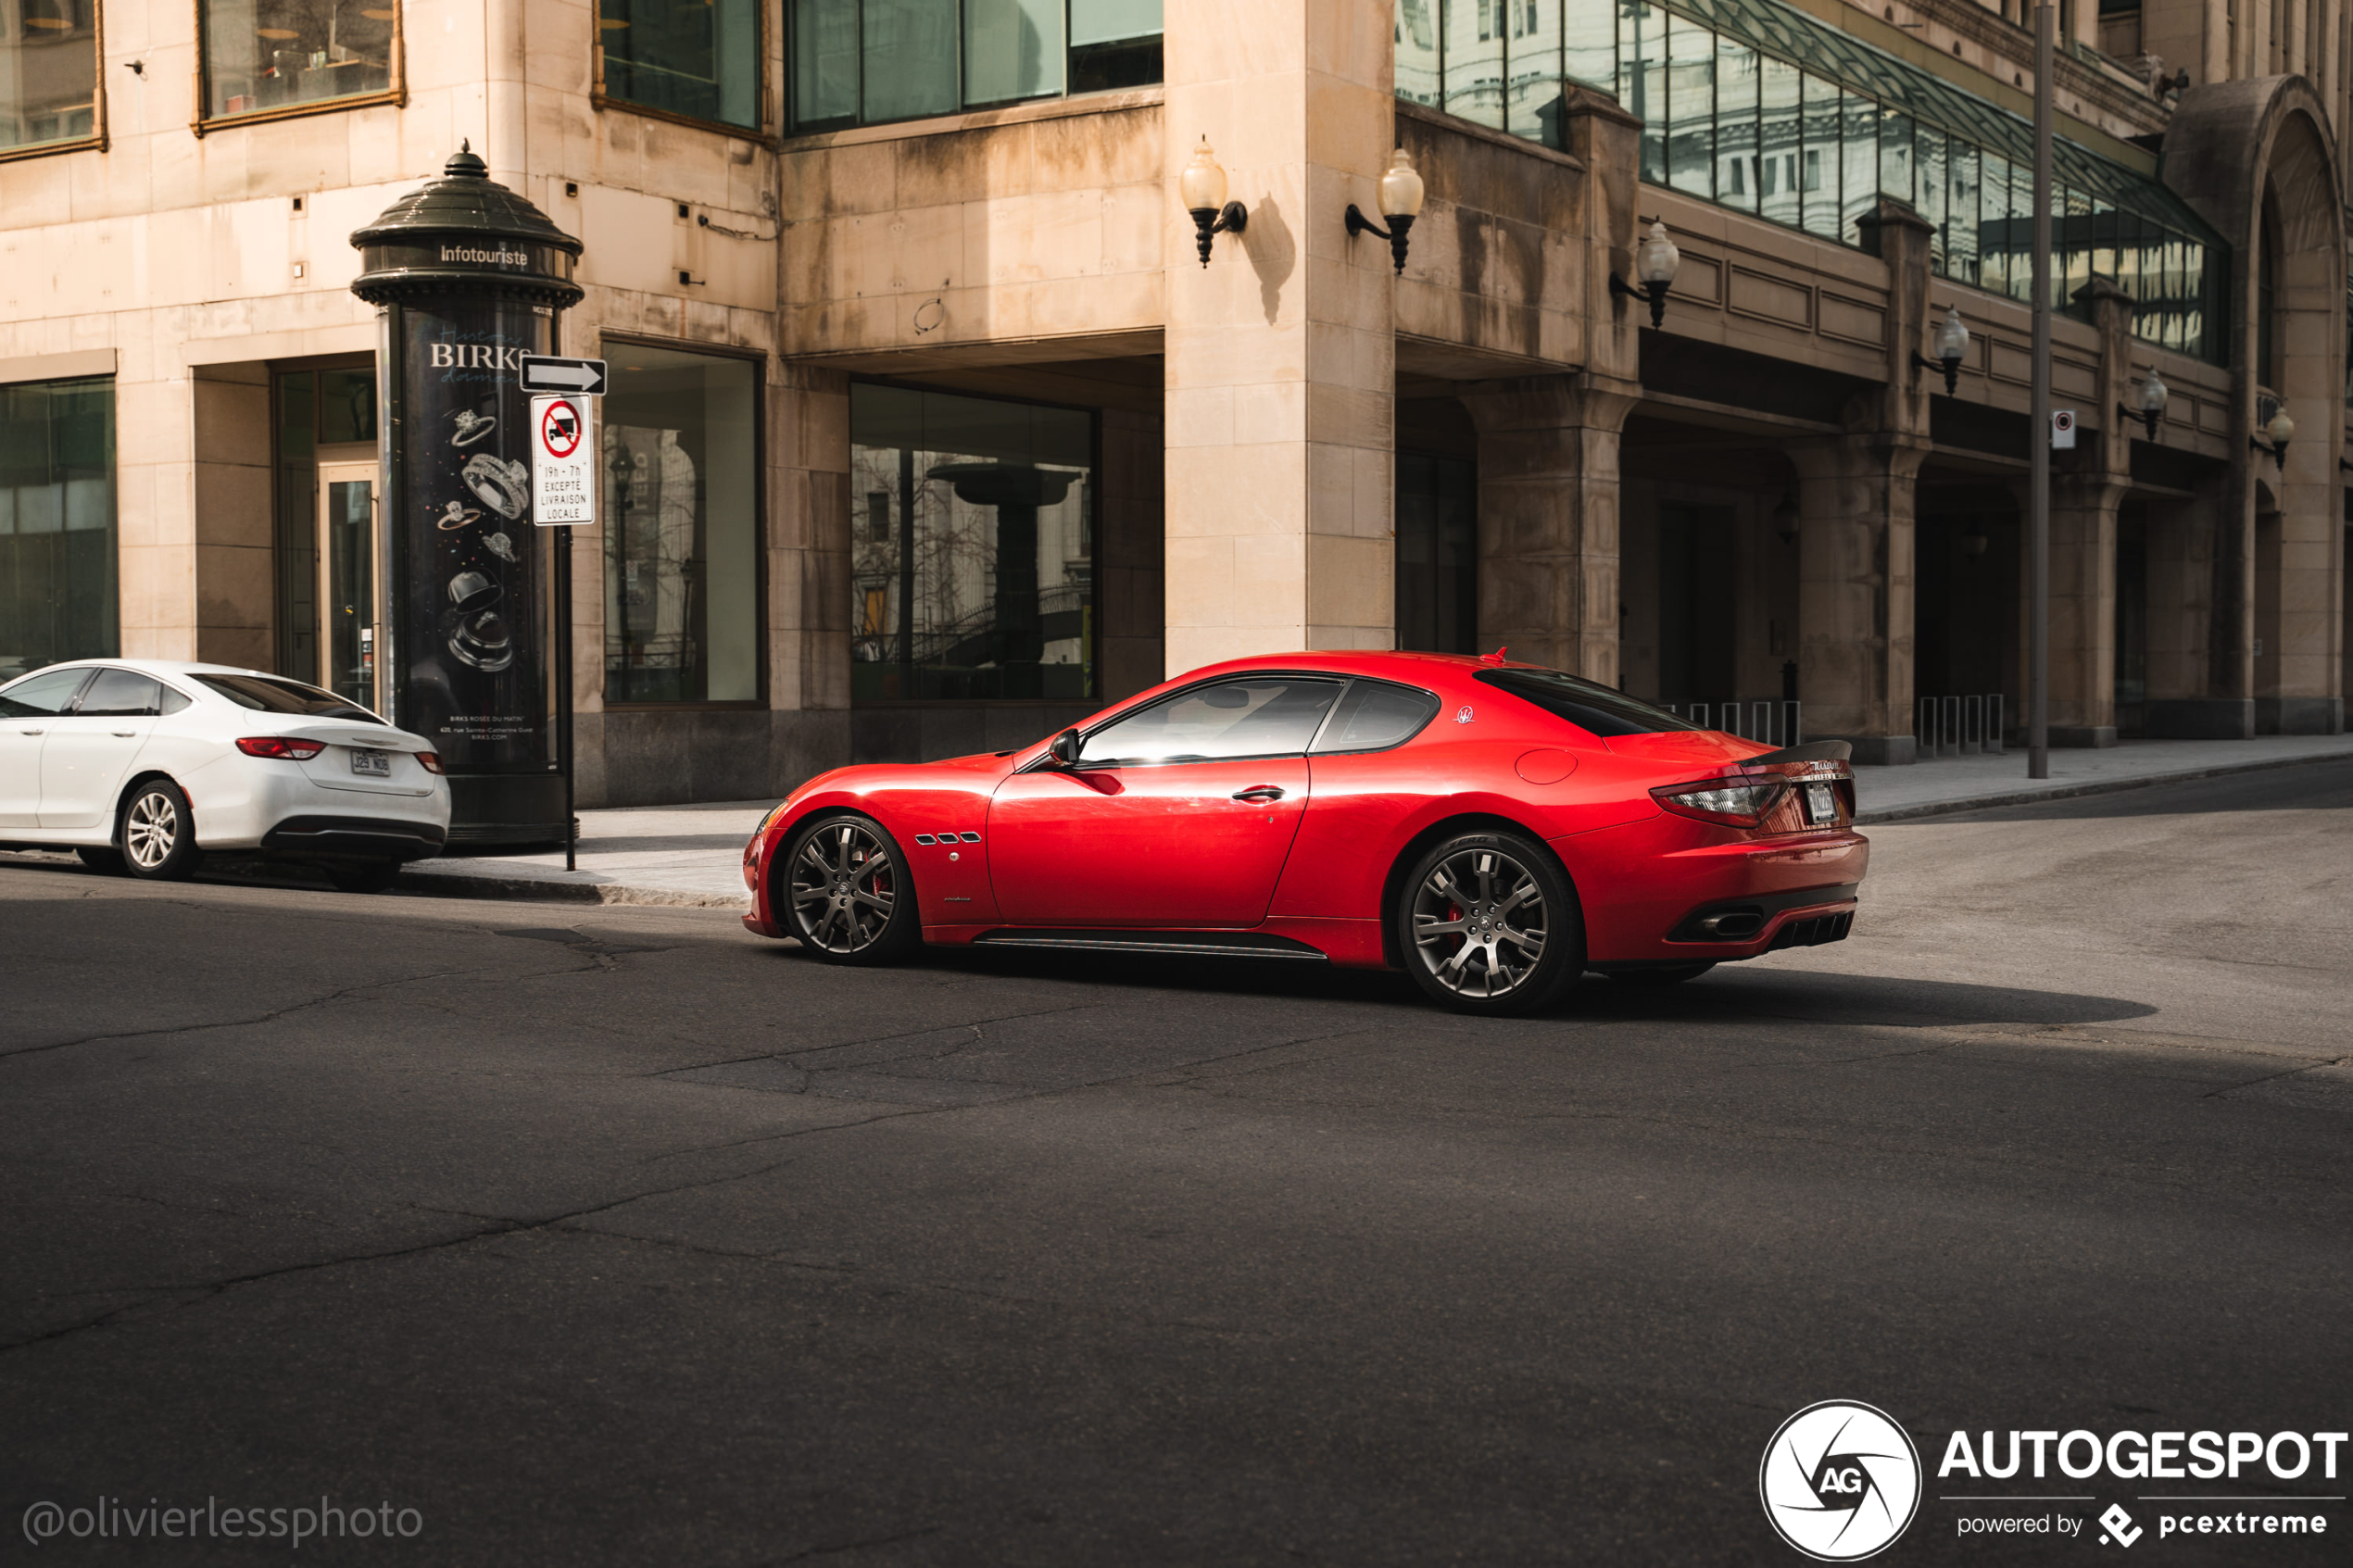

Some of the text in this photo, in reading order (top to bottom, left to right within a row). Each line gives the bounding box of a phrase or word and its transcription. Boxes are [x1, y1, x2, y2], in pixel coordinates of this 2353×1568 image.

[441, 245, 528, 266] Infotouriste
[430, 344, 532, 370] BIRK
[545, 466, 559, 478] 19h
[570, 465, 581, 477] 7h
[545, 478, 581, 492] EXCEPTÉ
[540, 494, 586, 506] LIVRAISON
[547, 508, 580, 520] LOCALE
[355, 756, 370, 769] J29
